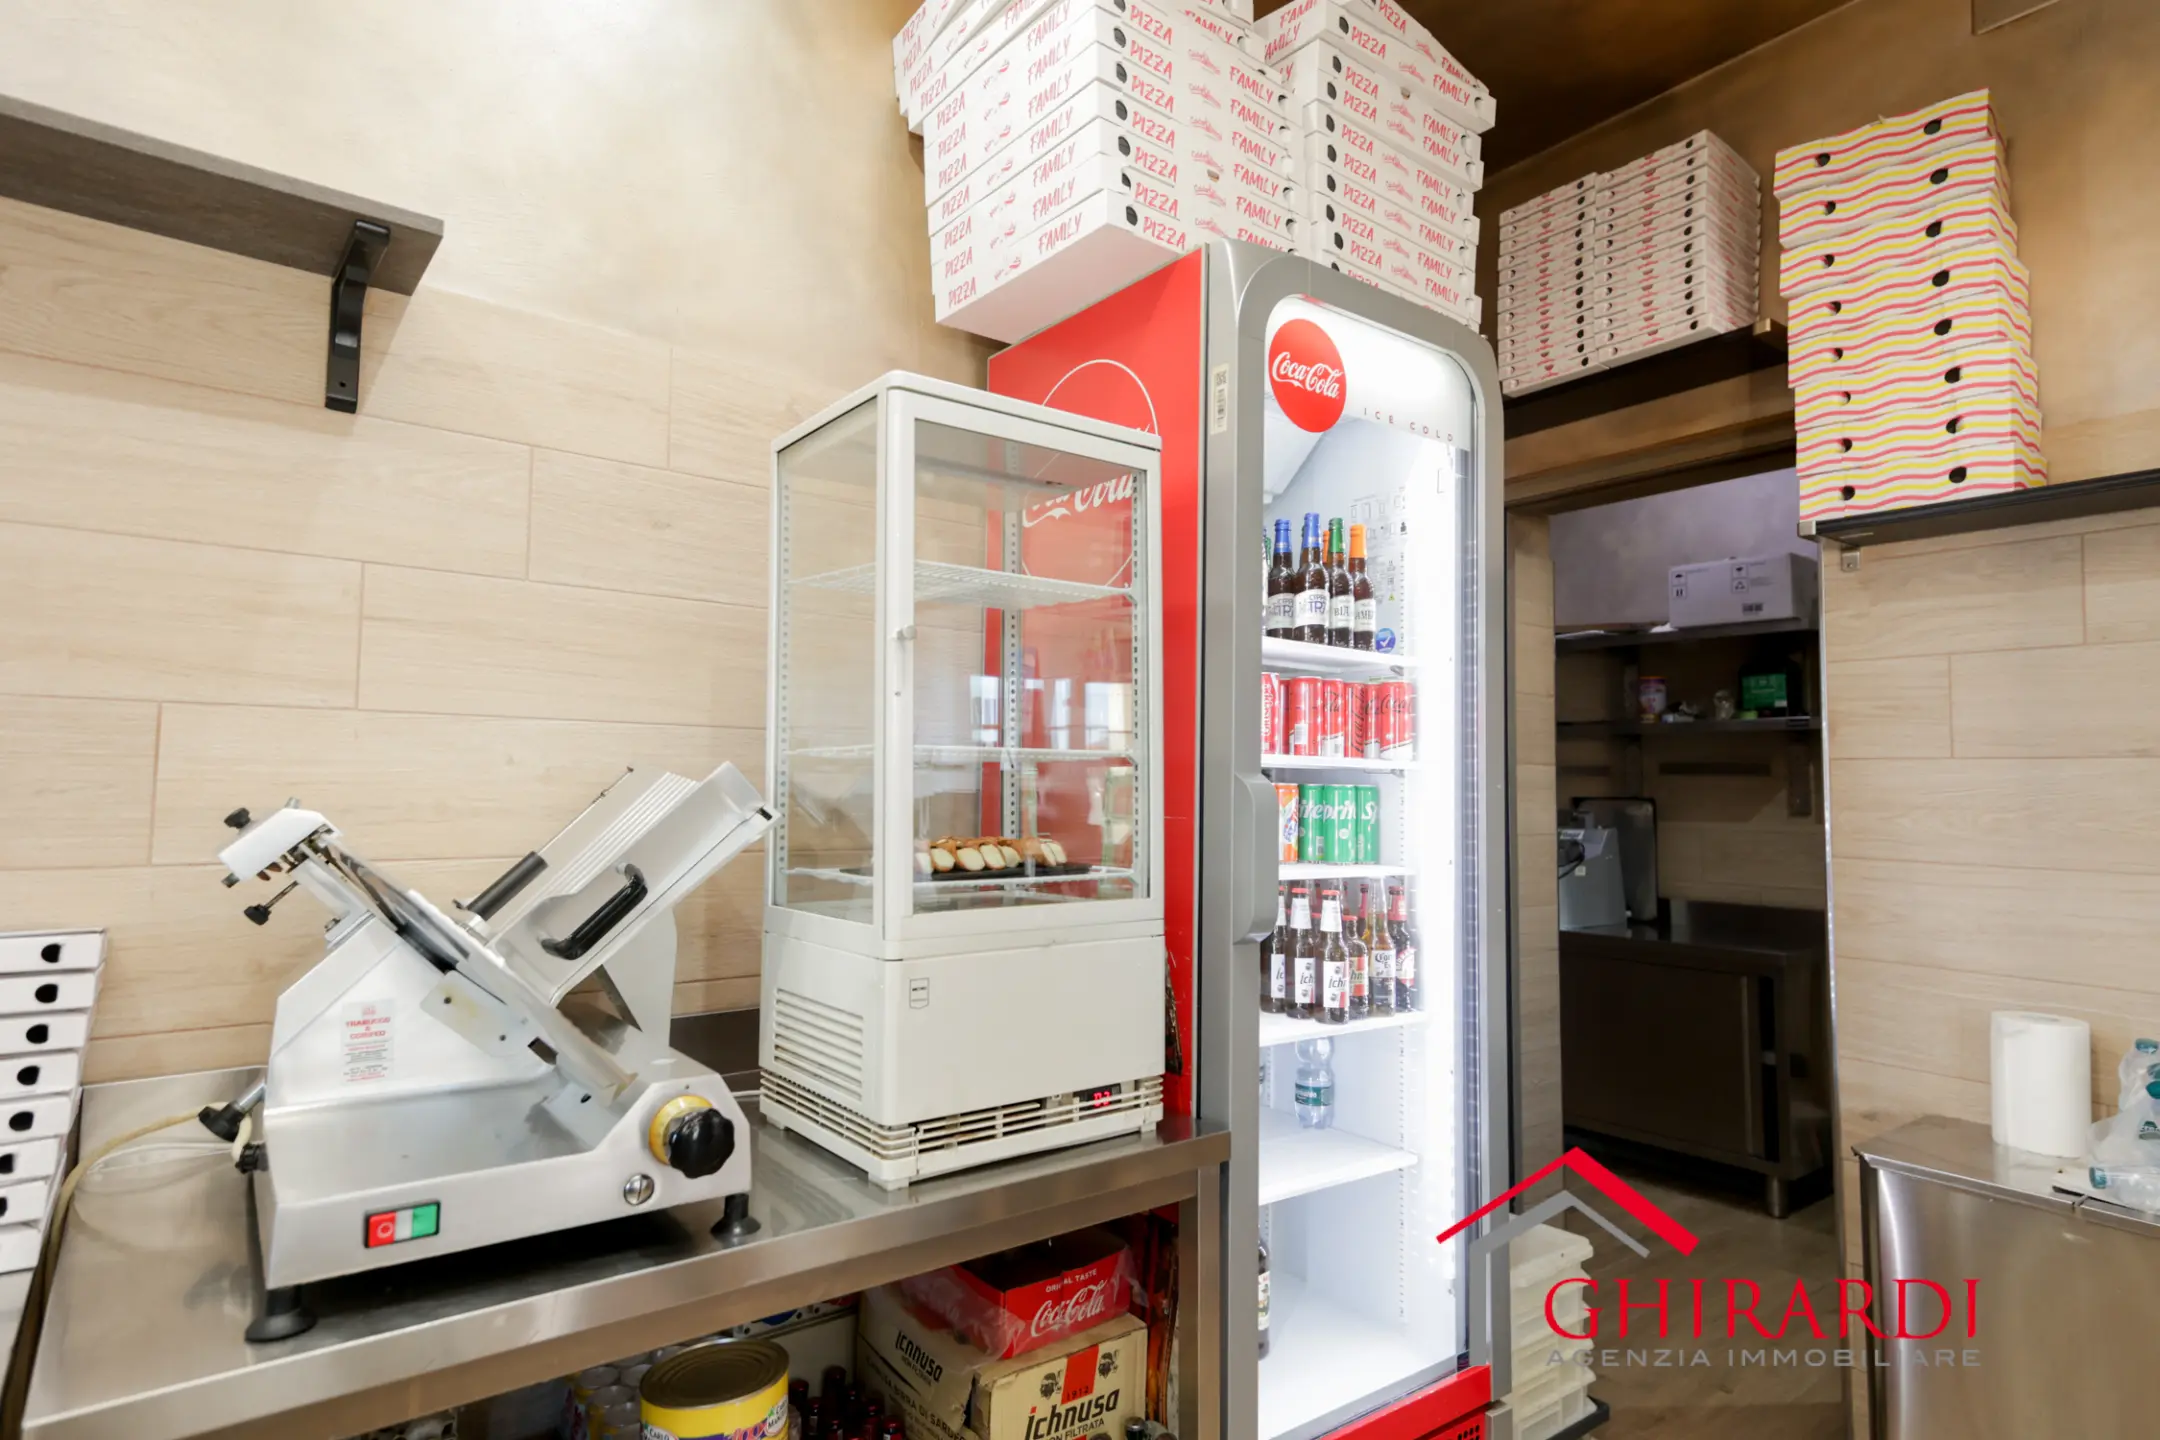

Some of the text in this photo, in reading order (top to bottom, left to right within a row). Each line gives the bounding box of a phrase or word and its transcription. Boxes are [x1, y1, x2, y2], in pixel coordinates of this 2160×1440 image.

[1130, 5, 1172, 45] PIZZA
[1229, 66, 1274, 104] FAMILY
[1264, 22, 1301, 60] AMILY
[1352, 26, 1470, 106] PIZZA FAMILY
[1130, 40, 1275, 136] PIZZA FAMILY
[1131, 75, 1277, 167] PIZZA FAMILY
[1345, 66, 1458, 144] PIZZA FAMILY
[1132, 111, 1280, 198] PIZZA FAMILY
[1341, 124, 1451, 199] PIZZA FAMILY
[1343, 90, 1460, 167] PIZZA FAMILY
[1135, 146, 1281, 229] PIZZA FAMILY
[1135, 182, 1179, 218] PIZZA
[1344, 153, 1457, 225] PIZZA FAMILY
[1344, 183, 1454, 252] PIZZA FAMILY
[1143, 216, 1187, 250] PIZZA
[1342, 213, 1452, 280] PIZZA FAMILY
[1351, 240, 1459, 305] PIZZA FAMILY
[1272, 352, 1344, 399] Coca-Cola
[1363, 407, 1454, 442] ICE COLD
[1031, 1279, 1108, 1337] Coca-Cola
[1075, 1268, 1097, 1282] TASTE
[1024, 1388, 1120, 1440] ichnusa
[1065, 1418, 1104, 1437] FILTRATA
